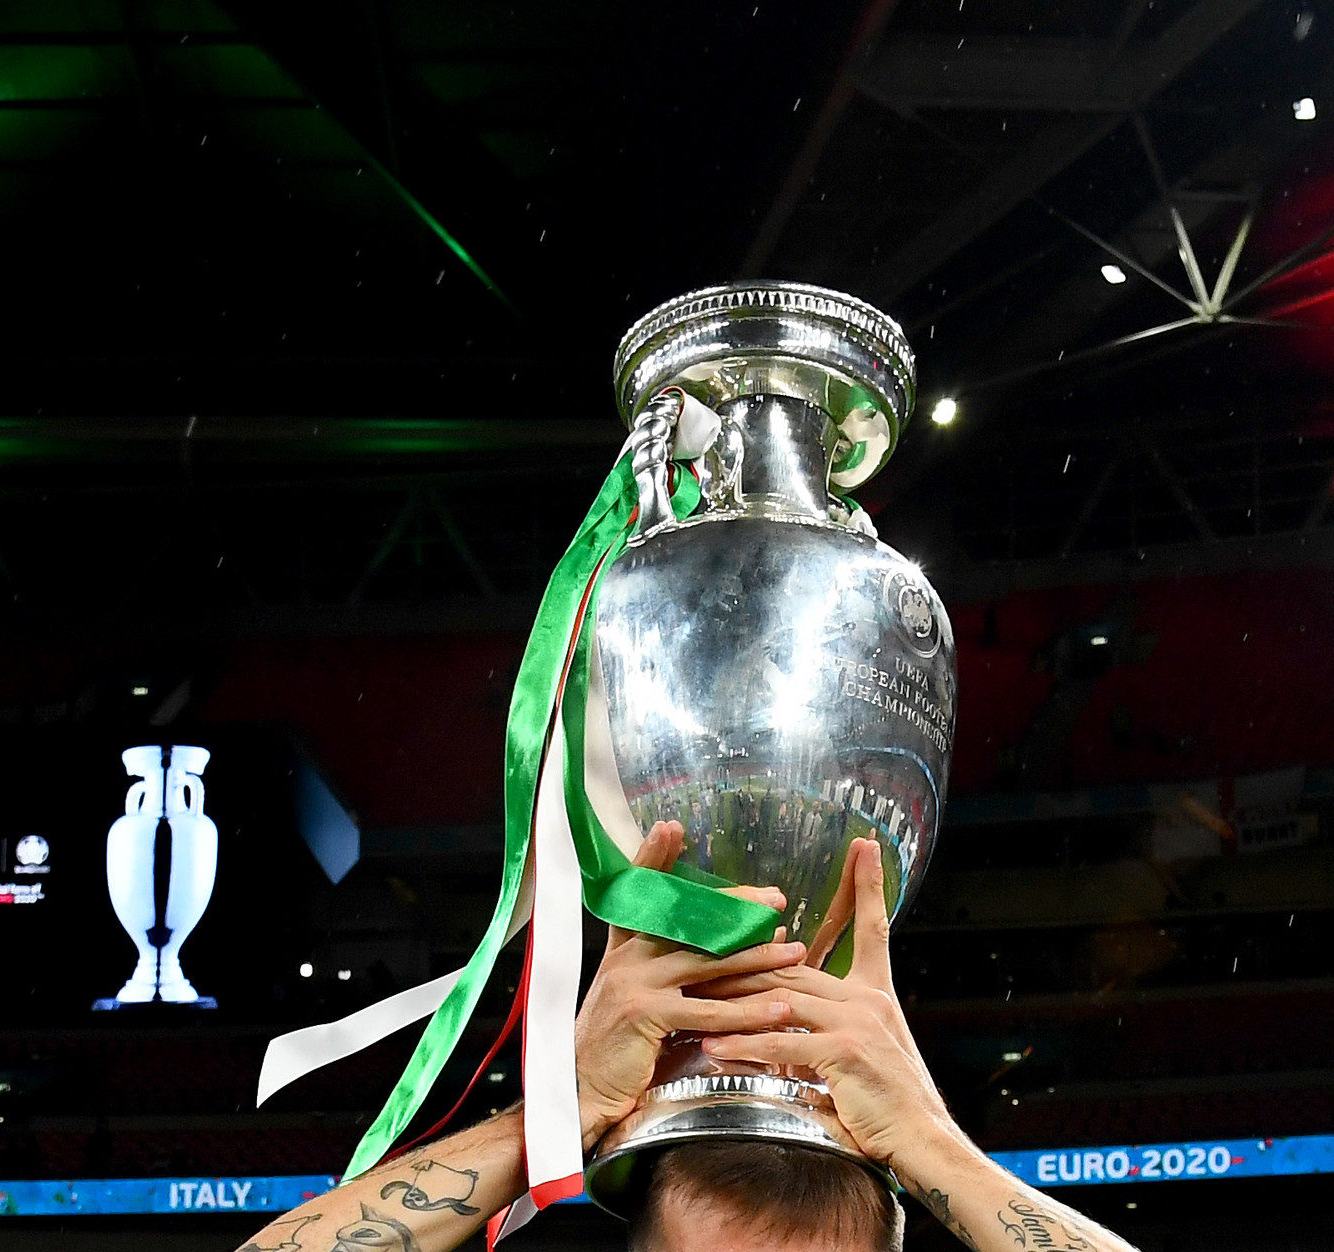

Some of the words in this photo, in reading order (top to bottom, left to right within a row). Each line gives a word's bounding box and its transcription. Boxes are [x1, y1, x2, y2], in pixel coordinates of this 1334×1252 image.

[895, 656, 929, 691] UEFA
[1037, 1151, 1130, 1182] EURO
[1140, 1145, 1232, 1178] 2020
[170, 1181, 254, 1210] ITALY
